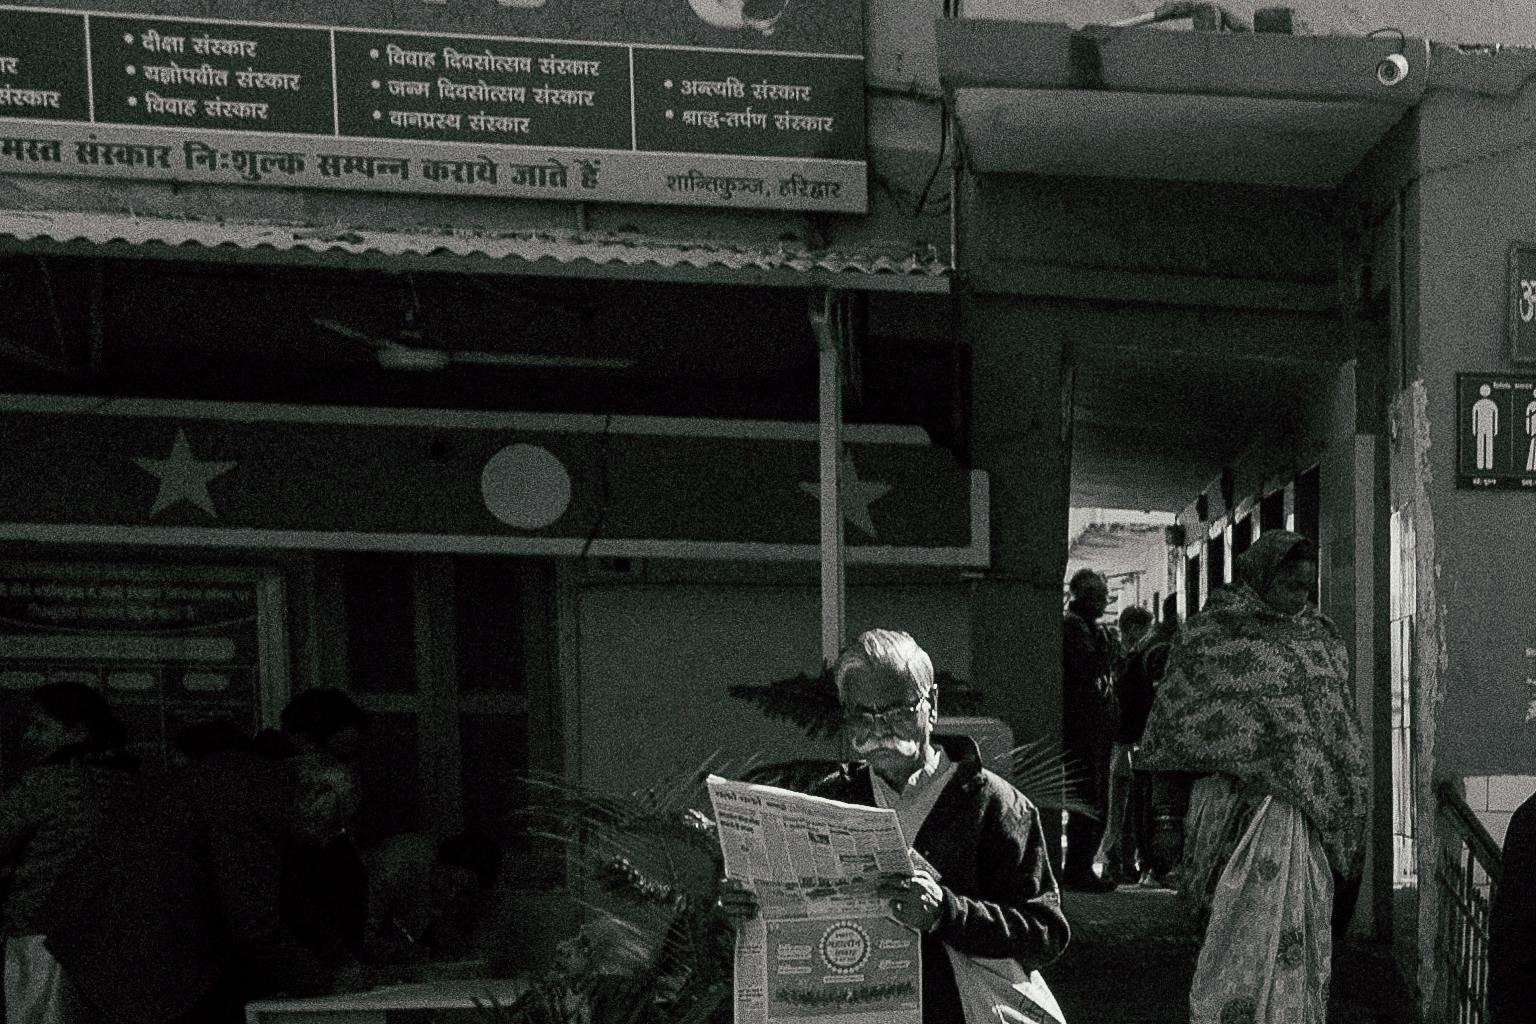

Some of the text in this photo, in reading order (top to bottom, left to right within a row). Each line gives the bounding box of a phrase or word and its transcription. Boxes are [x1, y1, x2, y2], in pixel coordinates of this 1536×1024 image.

[141, 29, 258, 57] दीक्षा संस्कार
[386, 45, 601, 77] विवाह दिवसोत्सव संस्कार
[142, 61, 300, 91] यज्ञोपवीत संस्कार
[751, 79, 812, 101] संस्कार
[145, 91, 270, 120] विवाह संस्कार
[388, 77, 596, 107] जन्म दिवसोत्सव संस्कार
[389, 110, 531, 134] वानप्रस्थ संस्कार
[774, 110, 835, 132] संस्कार
[0, 137, 61, 163] मस्त
[75, 134, 173, 169] संस्कार
[318, 153, 411, 180] सम्पन्न
[422, 154, 500, 185] कराये
[509, 157, 569, 189] जाते
[576, 157, 602, 190] हैं
[778, 172, 842, 199] हरिद्वार
